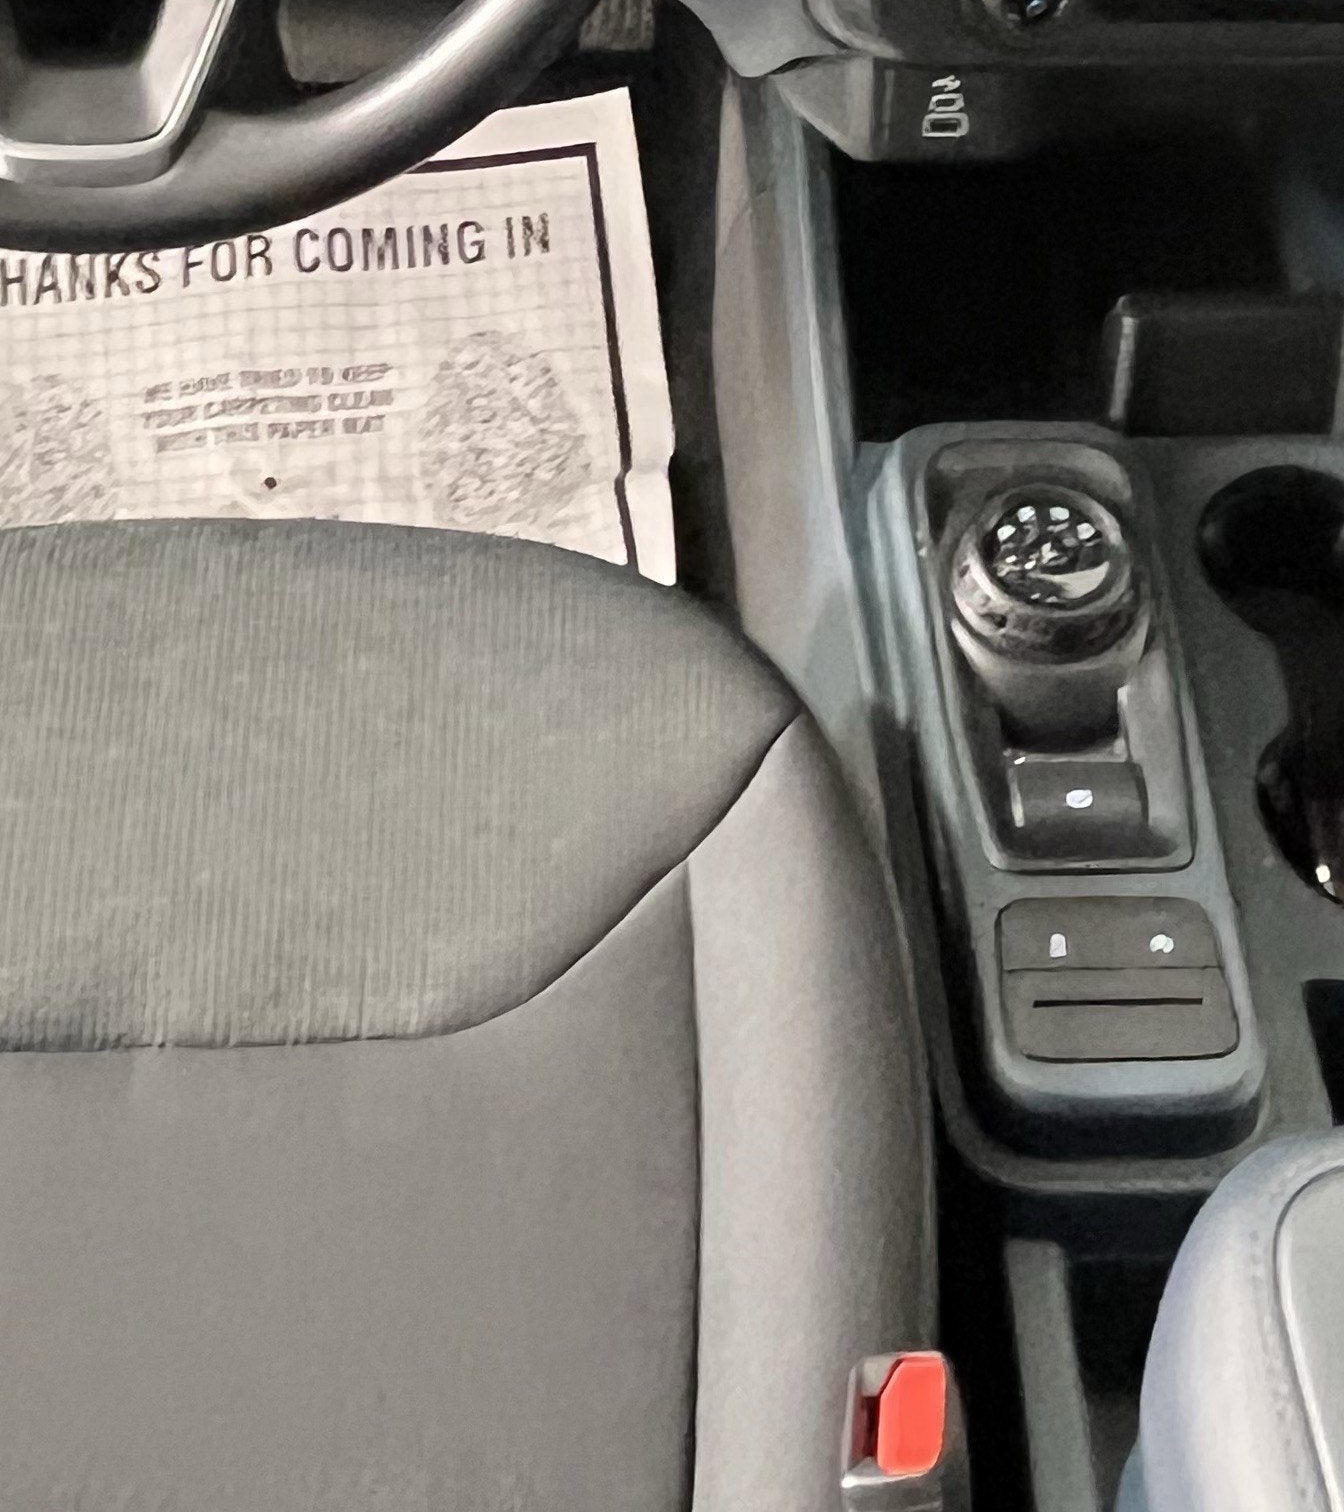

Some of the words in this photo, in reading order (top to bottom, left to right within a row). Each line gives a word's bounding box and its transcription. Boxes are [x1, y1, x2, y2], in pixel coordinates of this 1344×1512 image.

[182, 234, 273, 288] FOR
[294, 220, 486, 273] COMING
[505, 212, 551, 260] IN
